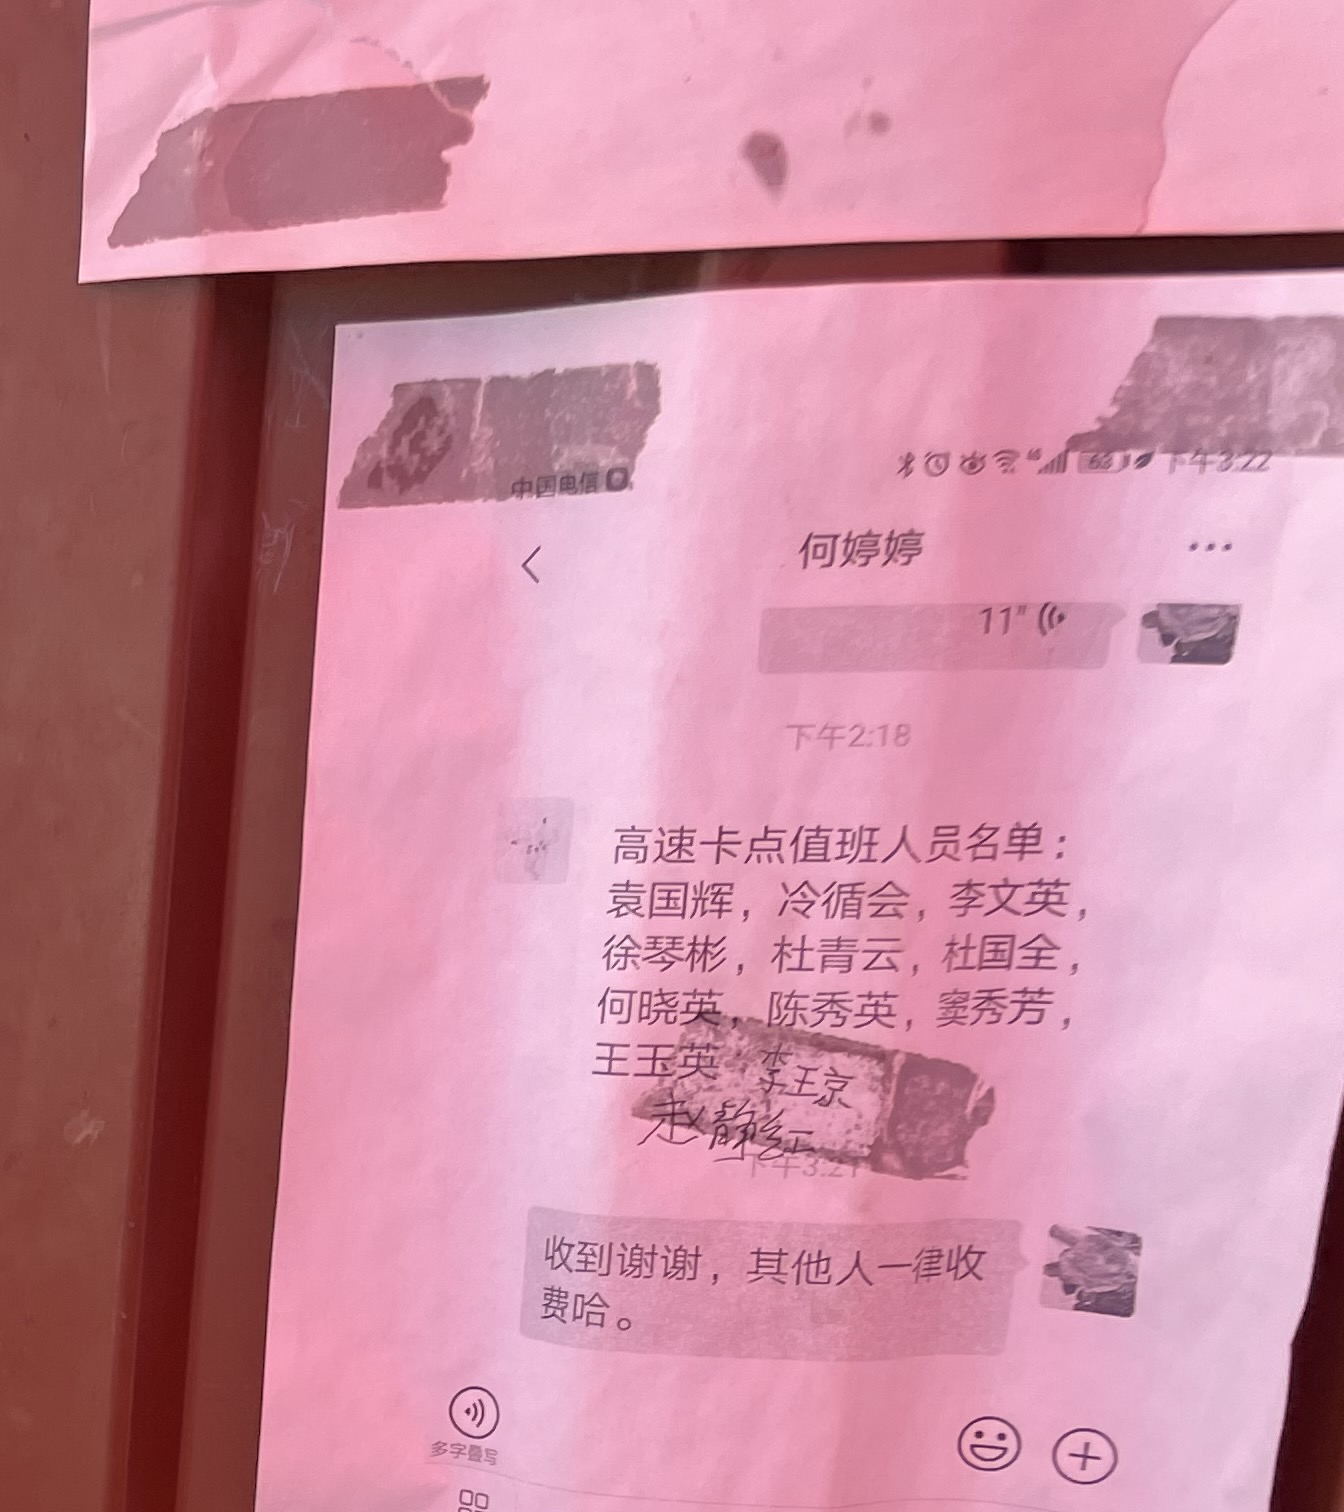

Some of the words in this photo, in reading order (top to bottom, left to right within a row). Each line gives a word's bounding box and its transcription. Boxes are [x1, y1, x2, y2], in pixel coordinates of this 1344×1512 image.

[511, 471, 600, 500] 中国电信
[798, 529, 925, 570] 何婷婷
[785, 722, 911, 751] 下午2:18
[591, 1041, 720, 1081] 王玉英
